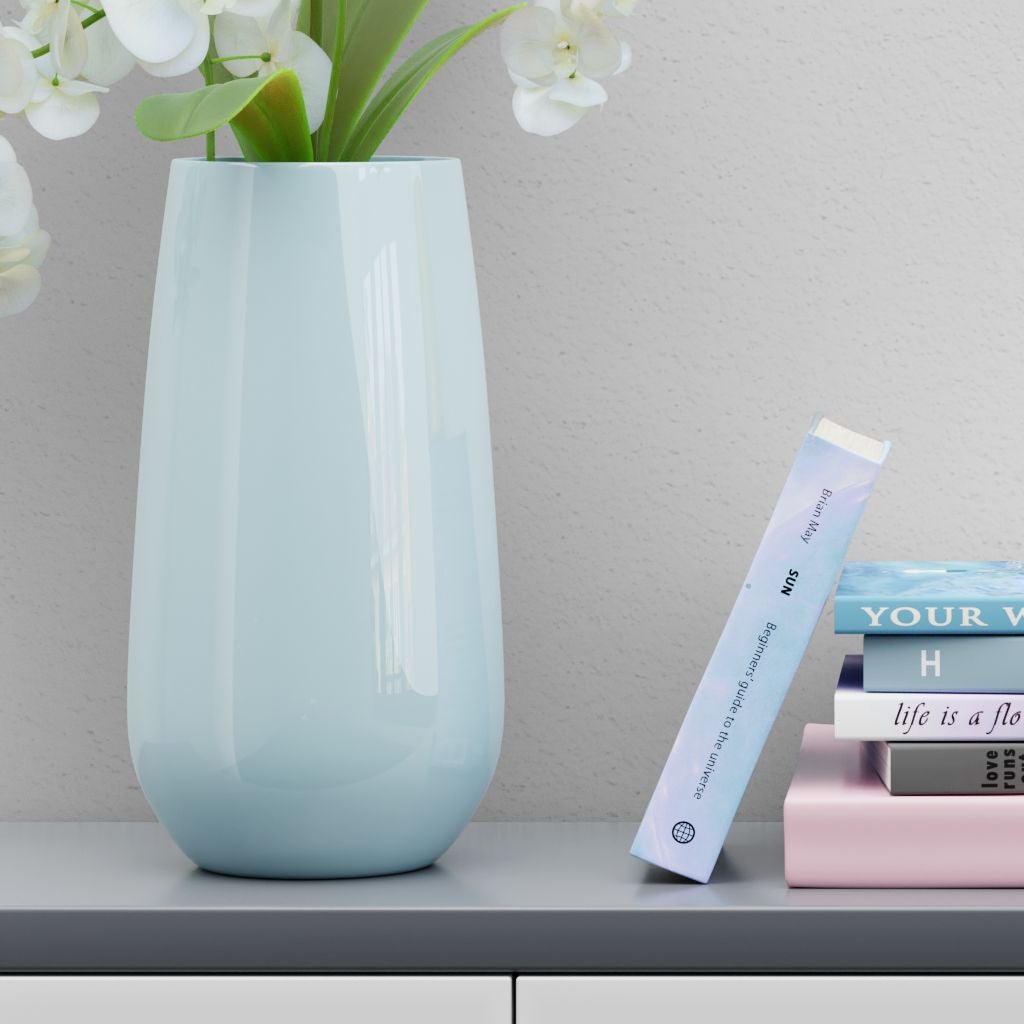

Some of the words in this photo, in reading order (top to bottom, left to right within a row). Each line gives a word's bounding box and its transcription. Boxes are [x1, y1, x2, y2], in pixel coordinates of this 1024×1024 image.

[812, 488, 832, 518] Brian
[800, 520, 819, 545] May
[781, 569, 799, 596] SUN
[861, 606, 988, 627] YOUR
[729, 681, 749, 713] guide
[723, 716, 735, 728] to
[894, 702, 930, 735] life
[941, 706, 958, 726] is
[968, 710, 984, 726] a
[714, 731, 729, 750] the
[693, 752, 719, 800] universe
[981, 750, 999, 788] love
[1003, 749, 1016, 789] runs
